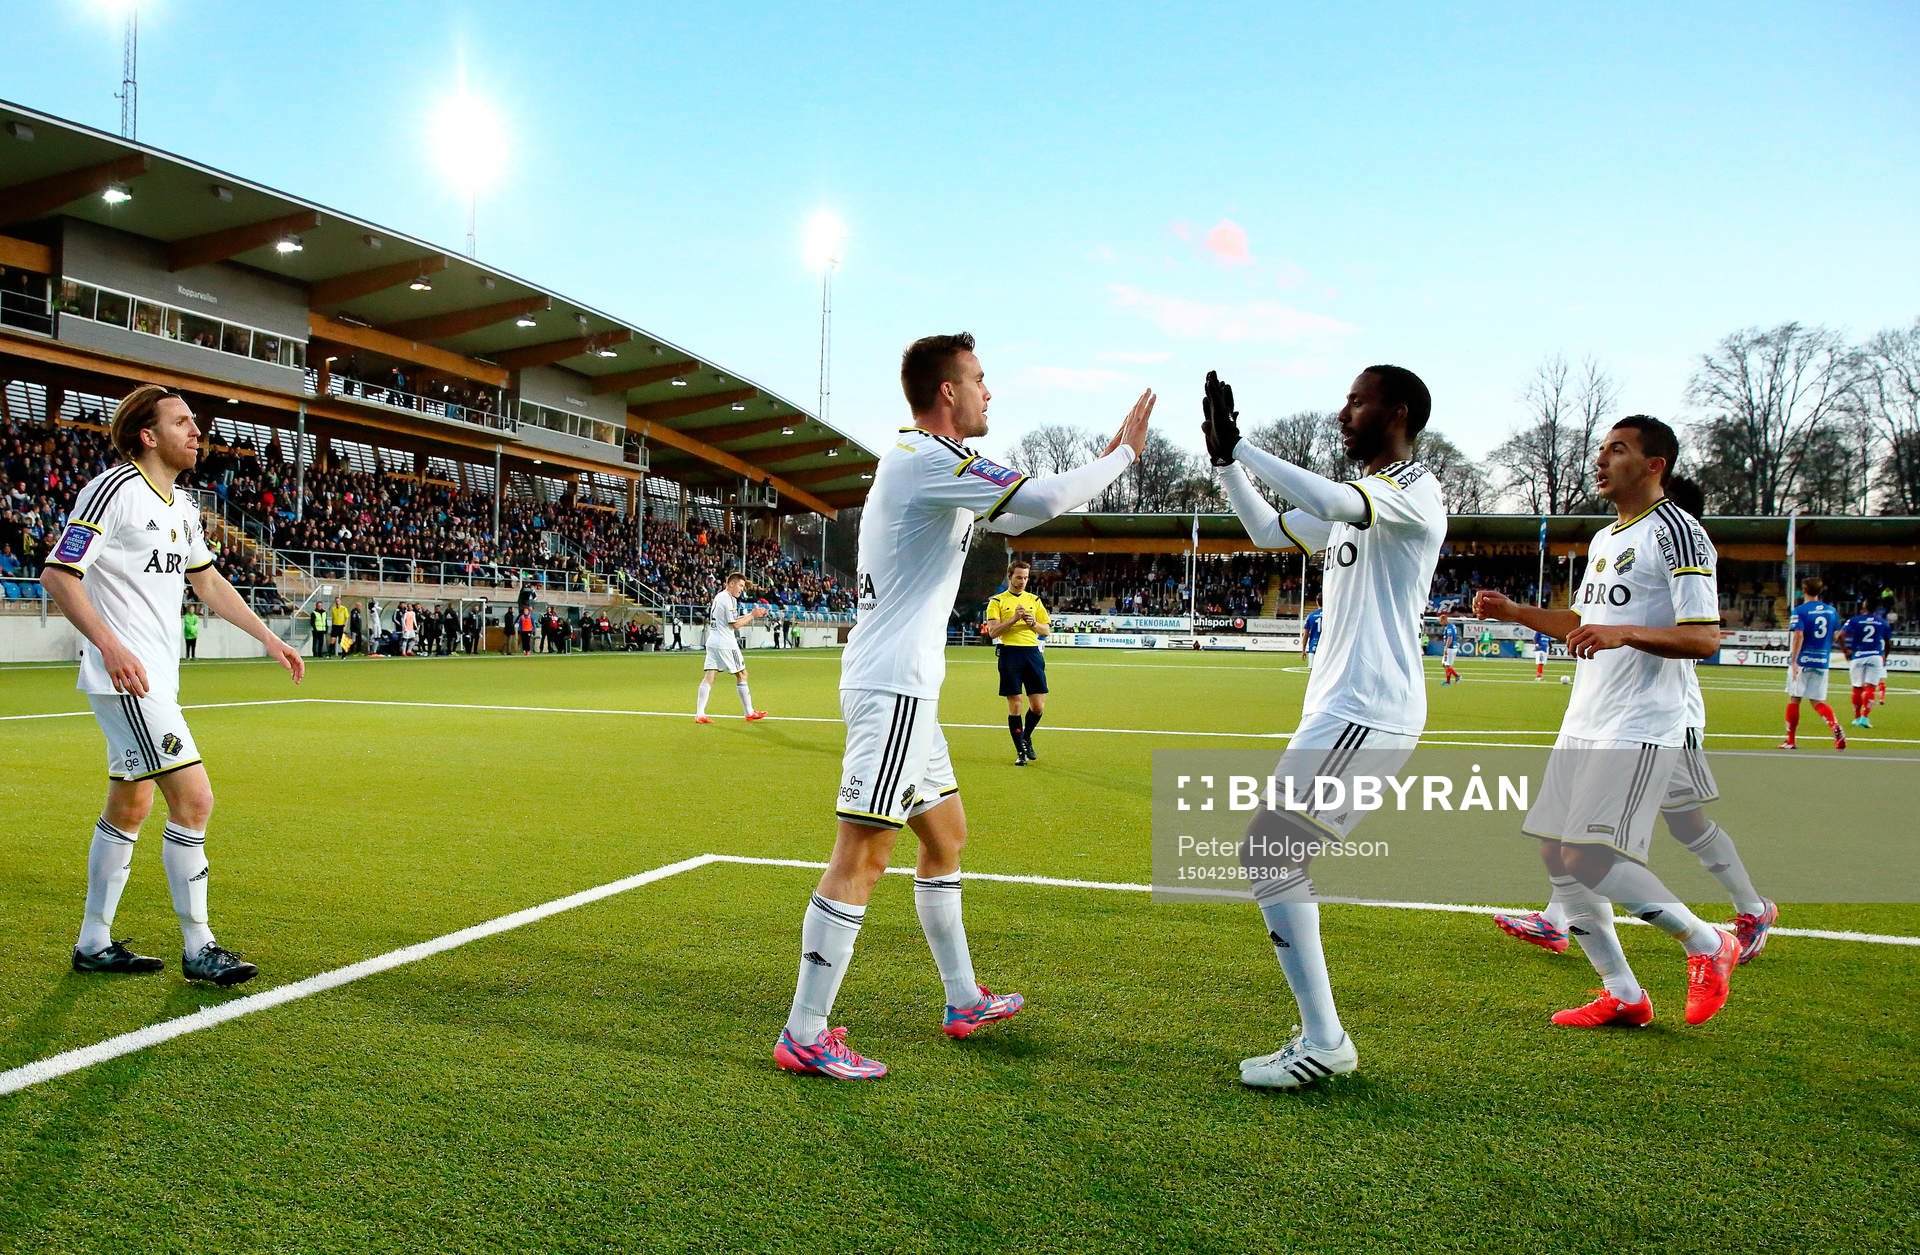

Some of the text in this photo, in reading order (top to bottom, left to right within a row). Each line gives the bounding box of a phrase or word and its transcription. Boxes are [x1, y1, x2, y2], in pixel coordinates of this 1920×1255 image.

[1583, 583, 1632, 607] BRO
[1080, 620, 1101, 628] NCC
[1135, 619, 1180, 628] TEKNORAMA
[1193, 617, 1233, 628] uhlsport
[1814, 616, 1828, 639] 3
[1862, 625, 1876, 643] 2
